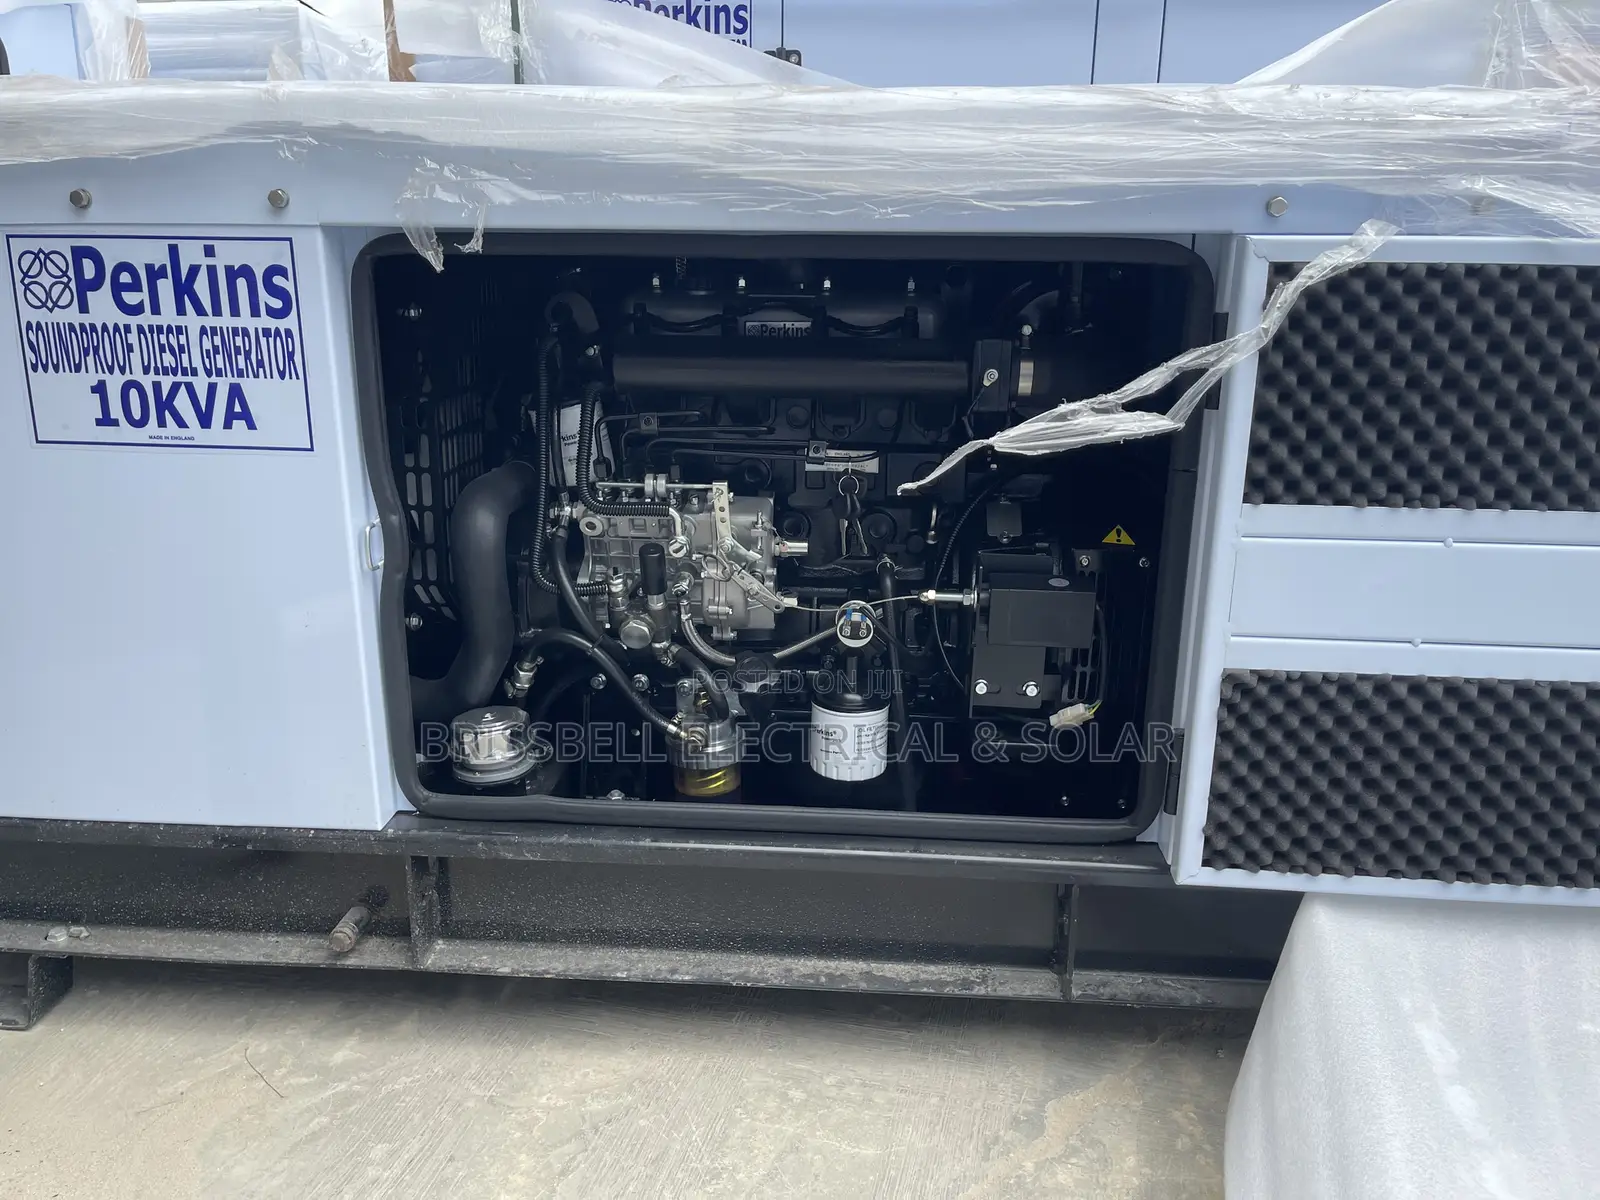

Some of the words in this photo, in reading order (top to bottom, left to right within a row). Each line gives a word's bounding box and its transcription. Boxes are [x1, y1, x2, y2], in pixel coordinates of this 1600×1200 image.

[70, 243, 293, 319] Perkins
[26, 320, 135, 376] SOUNDPROOF
[136, 323, 199, 378] DIESEL
[199, 324, 300, 381] GENERATOR
[90, 379, 258, 431] 10KVA
